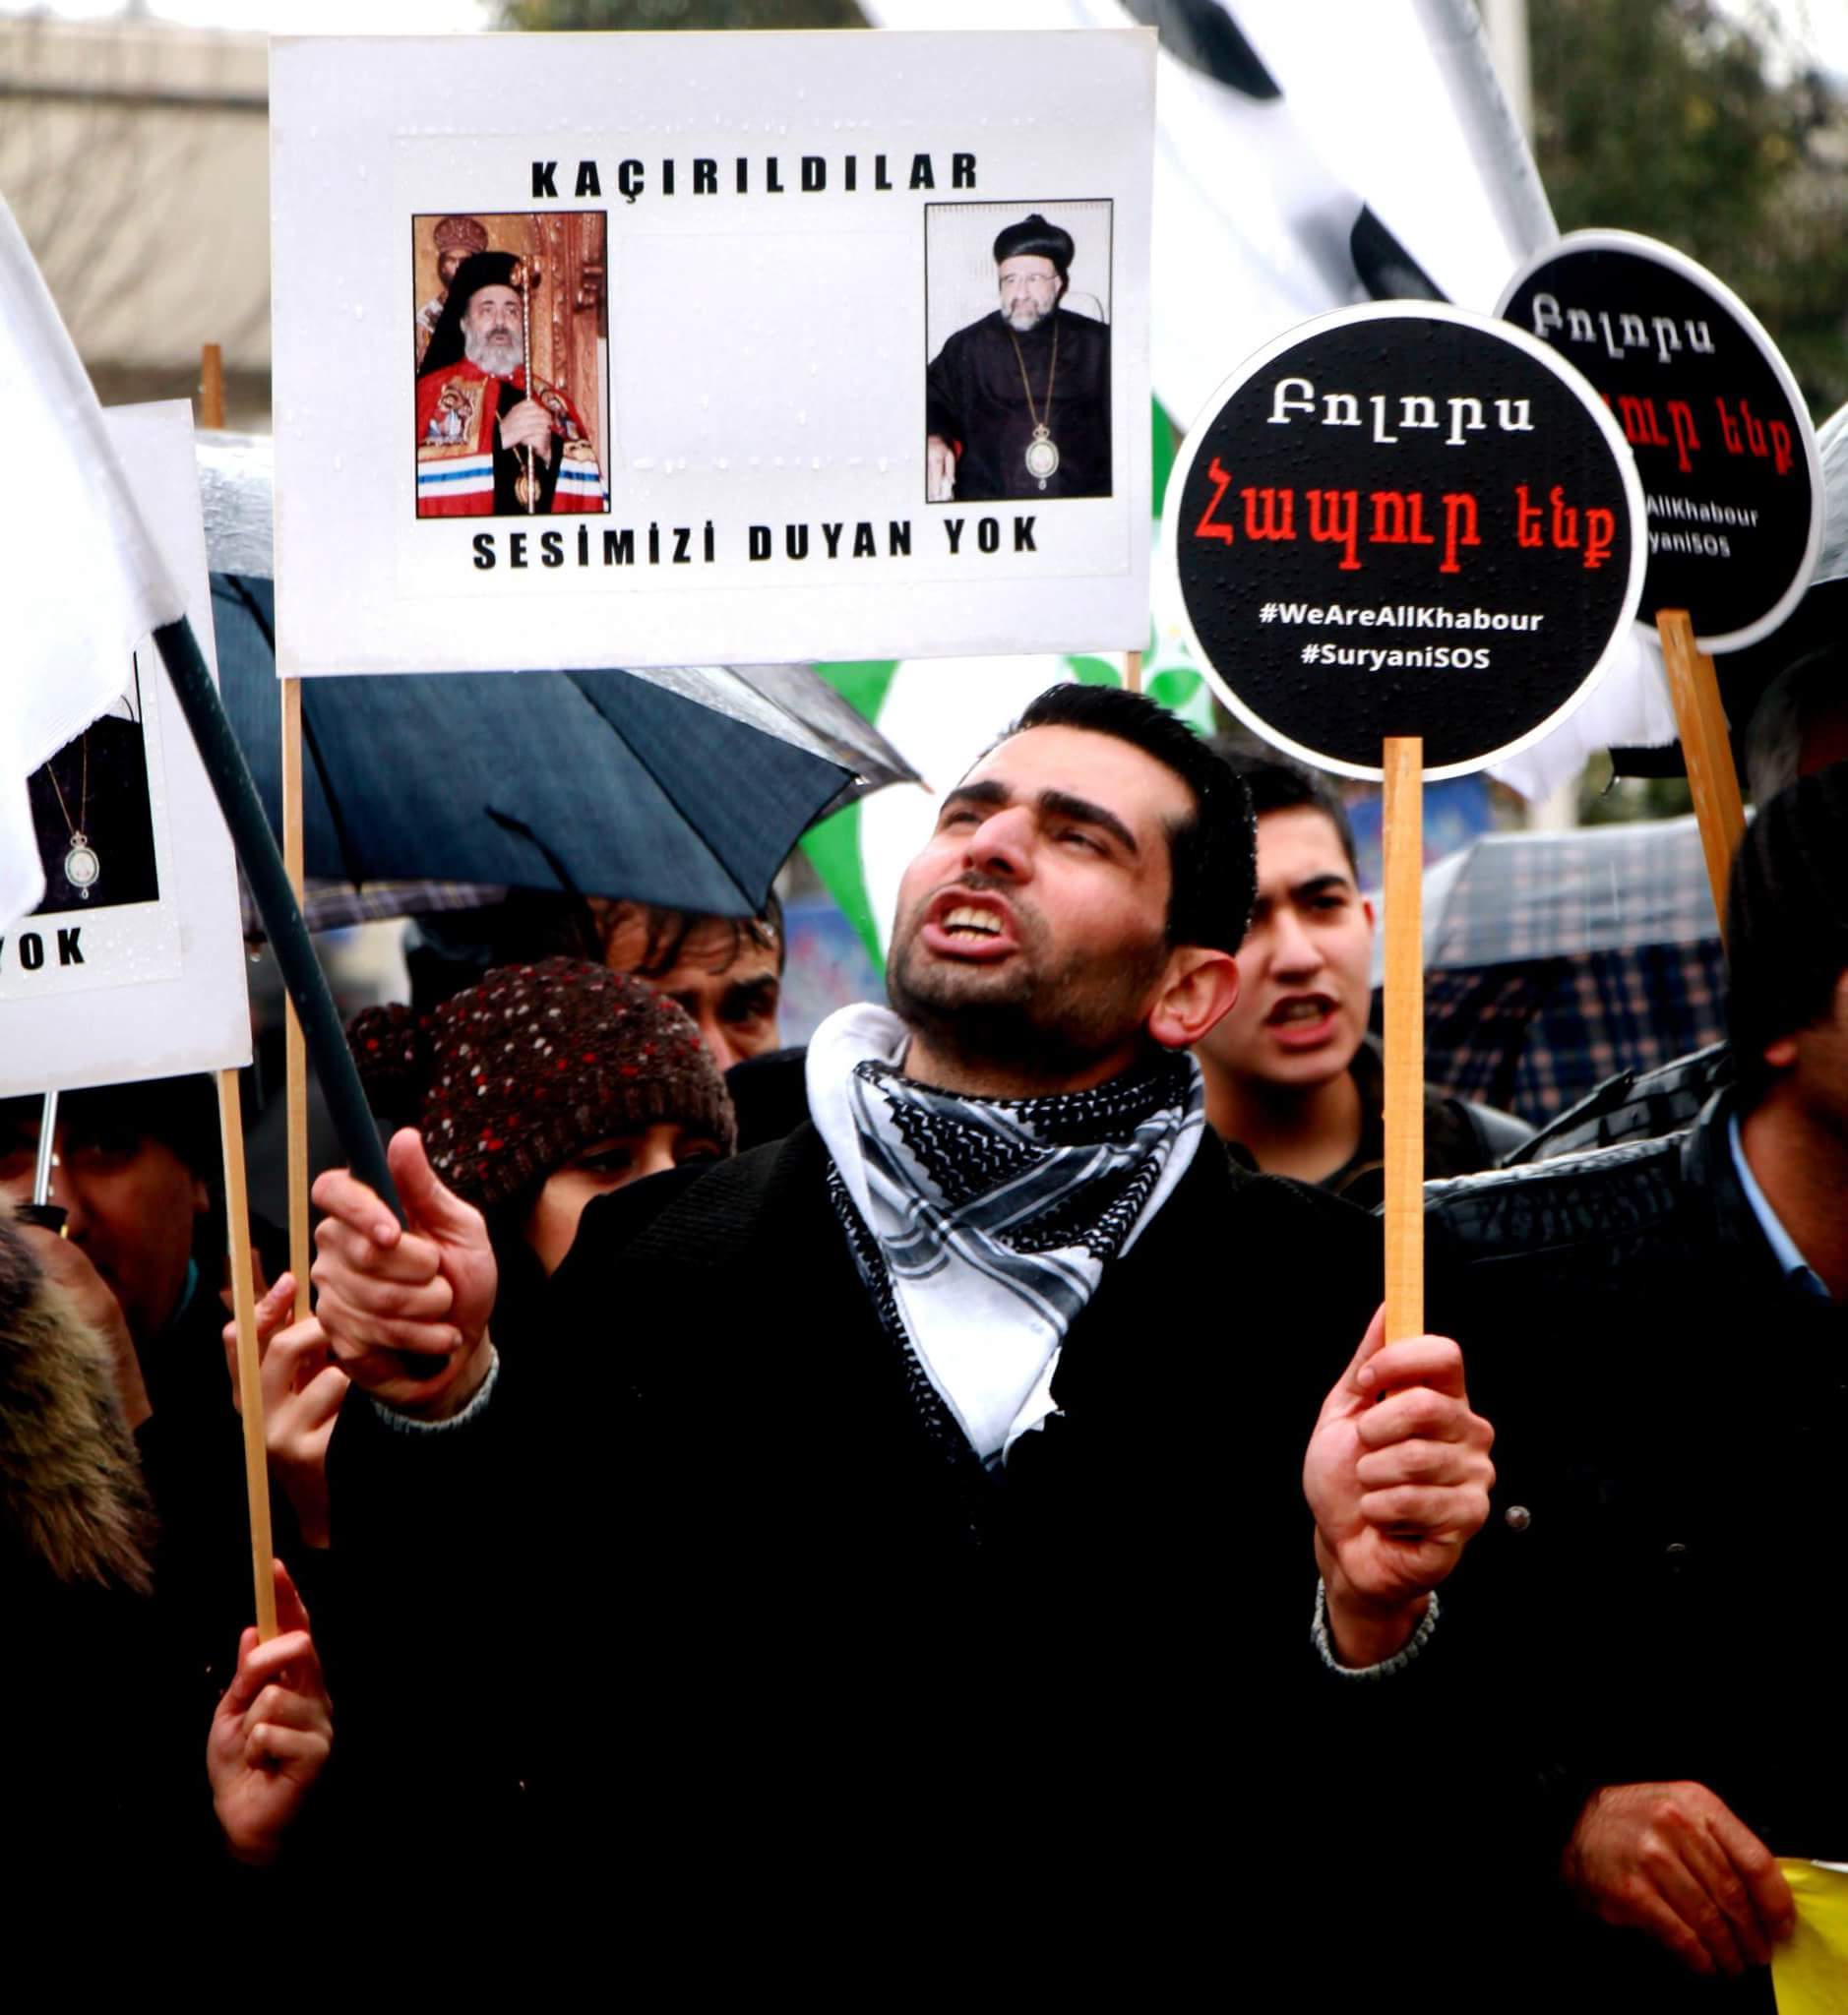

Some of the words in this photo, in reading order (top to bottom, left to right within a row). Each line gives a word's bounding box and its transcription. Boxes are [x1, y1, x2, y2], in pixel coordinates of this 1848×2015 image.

[532, 153, 979, 203] KAÇIRILDILAR
[1267, 378, 1535, 445] Բոլորս
[1195, 457, 1481, 573] Հապուր
[1515, 485, 1615, 568] ենք
[1647, 495, 1759, 527] AllKhabour
[473, 520, 713, 570] SESİMİZİ
[749, 520, 911, 561] DUYAN
[944, 516, 1038, 554] YOK
[1649, 530, 1732, 558] yaniSOS
[1259, 602, 1544, 632] #WeAreAllKhabour
[1301, 643, 1491, 671] #SuryaniSOS
[0, 927, 85, 971] OK
